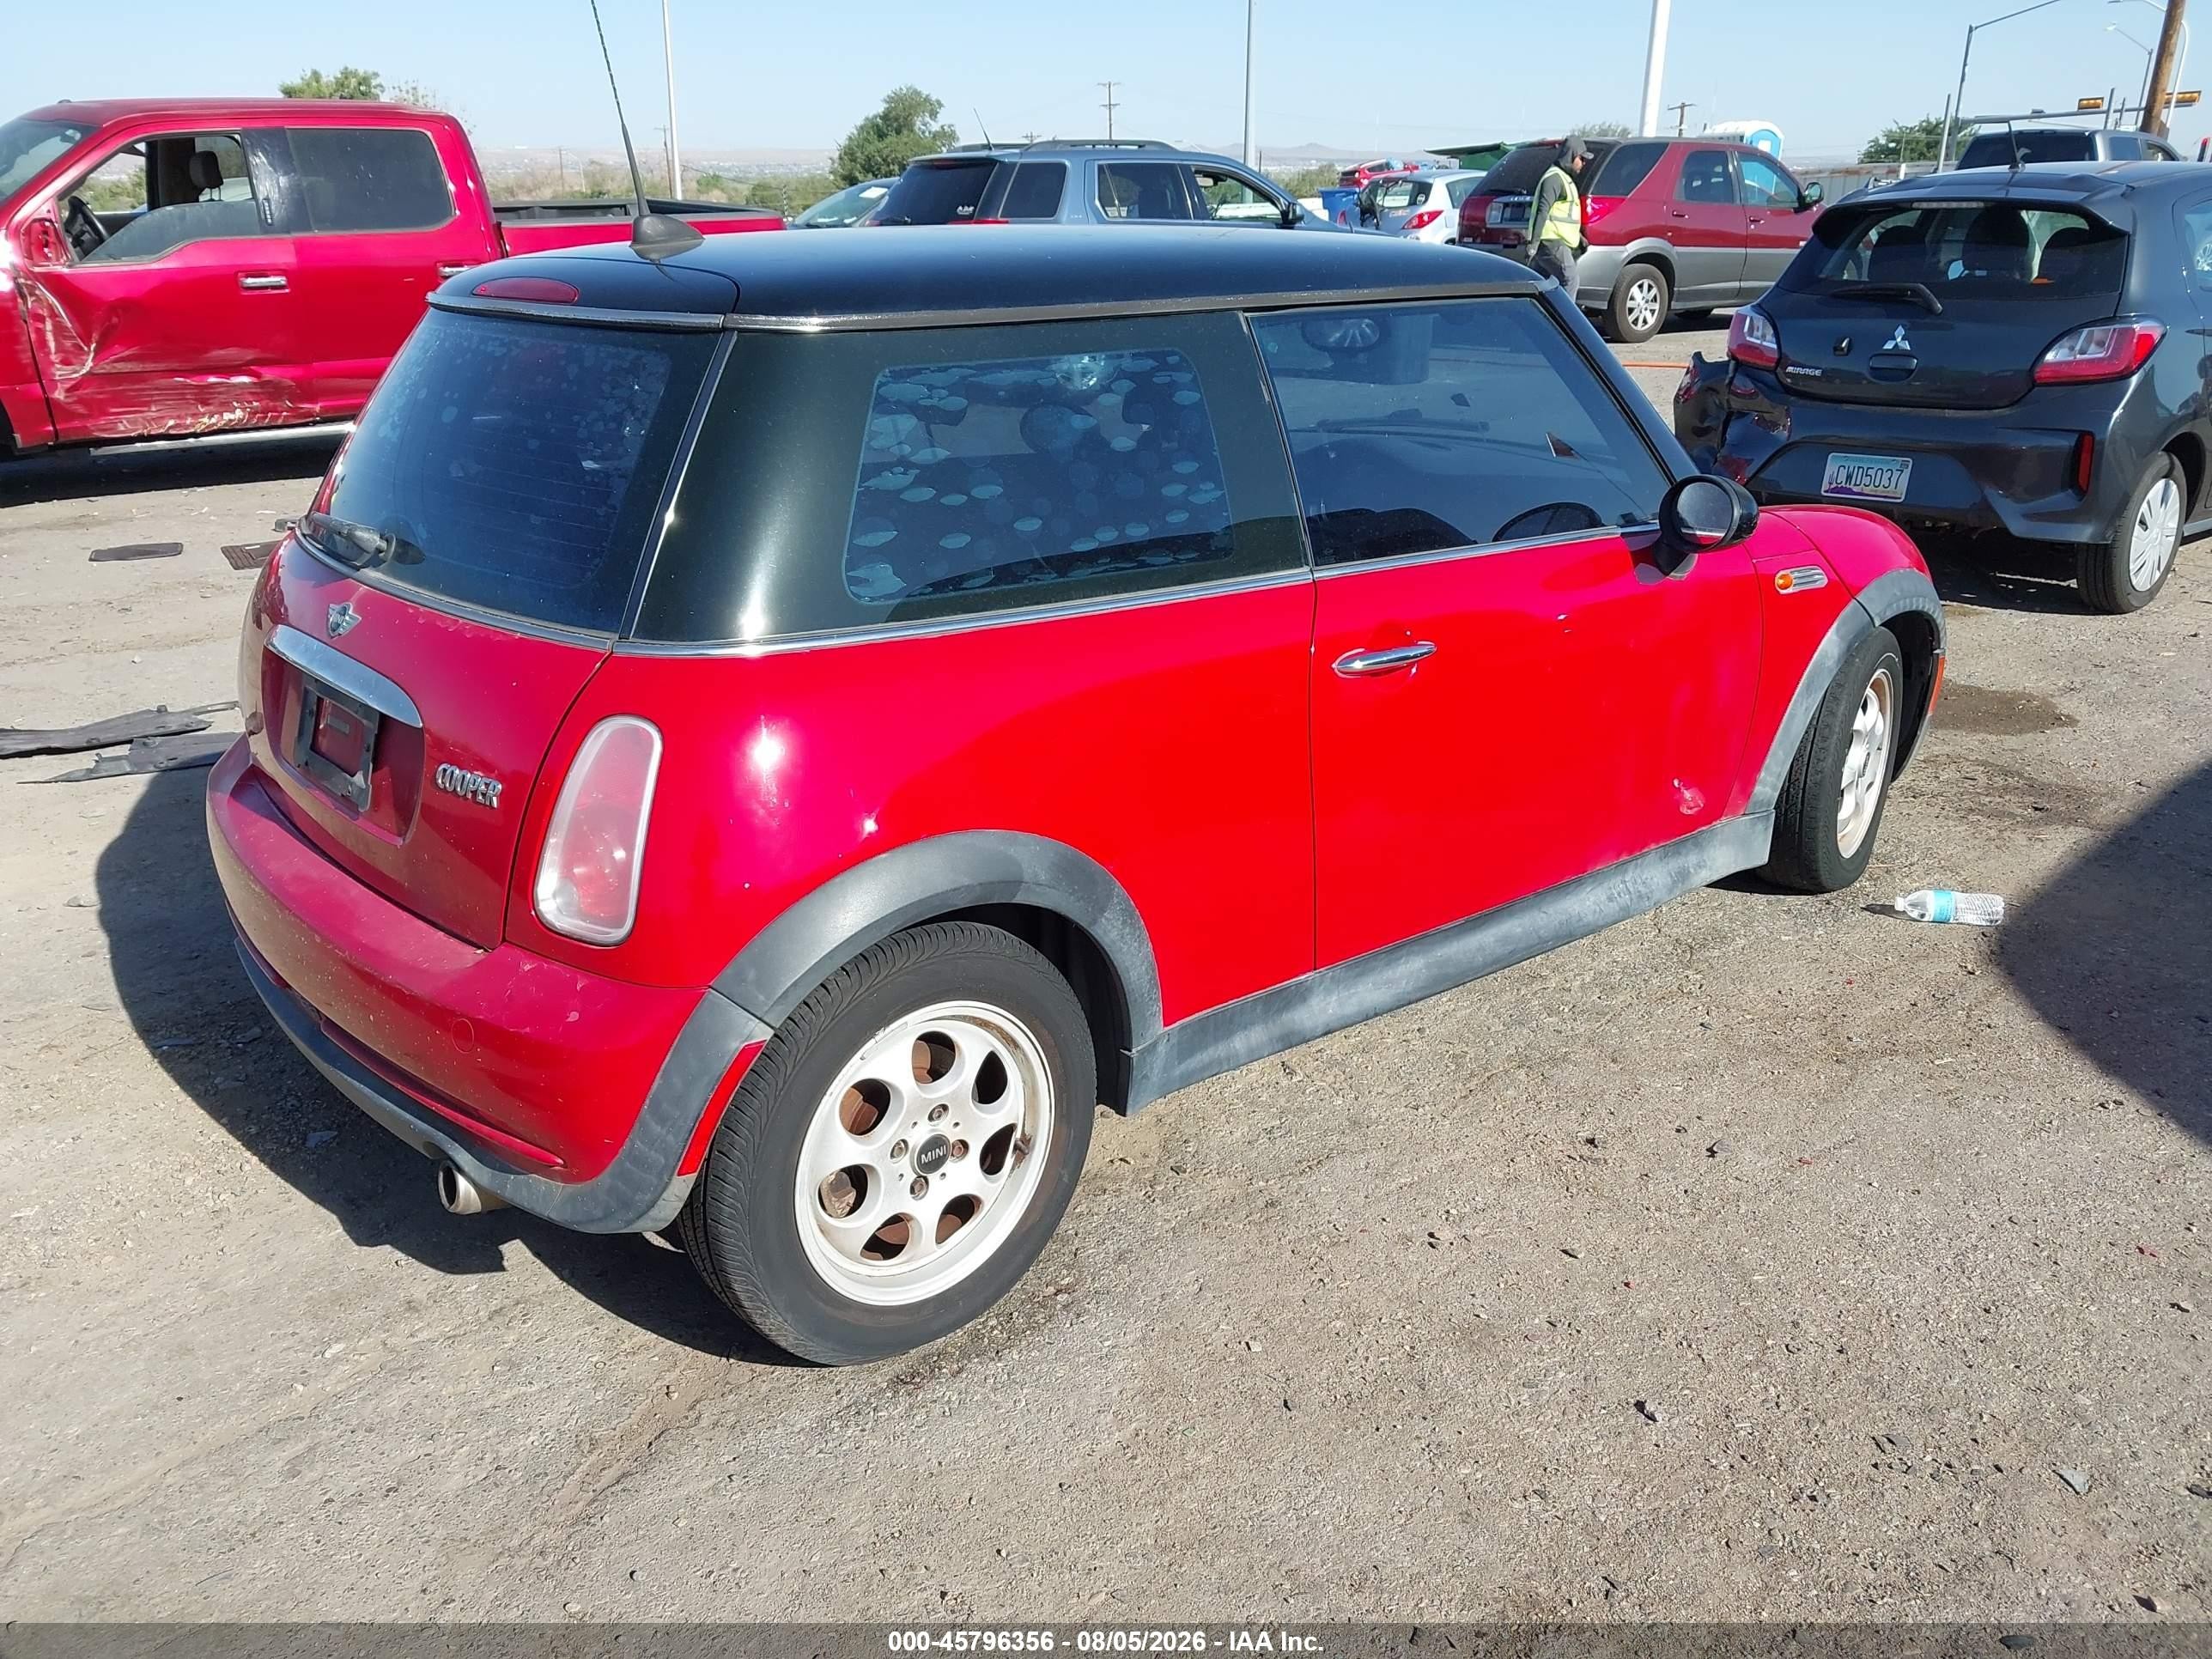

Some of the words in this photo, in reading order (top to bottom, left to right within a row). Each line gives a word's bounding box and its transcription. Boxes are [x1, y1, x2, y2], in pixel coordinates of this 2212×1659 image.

[1785, 366, 1822, 376] MIRAGE
[1834, 465, 1904, 490] CWD5037
[435, 763, 502, 809] COOPER
[921, 1145, 947, 1164] MINI
